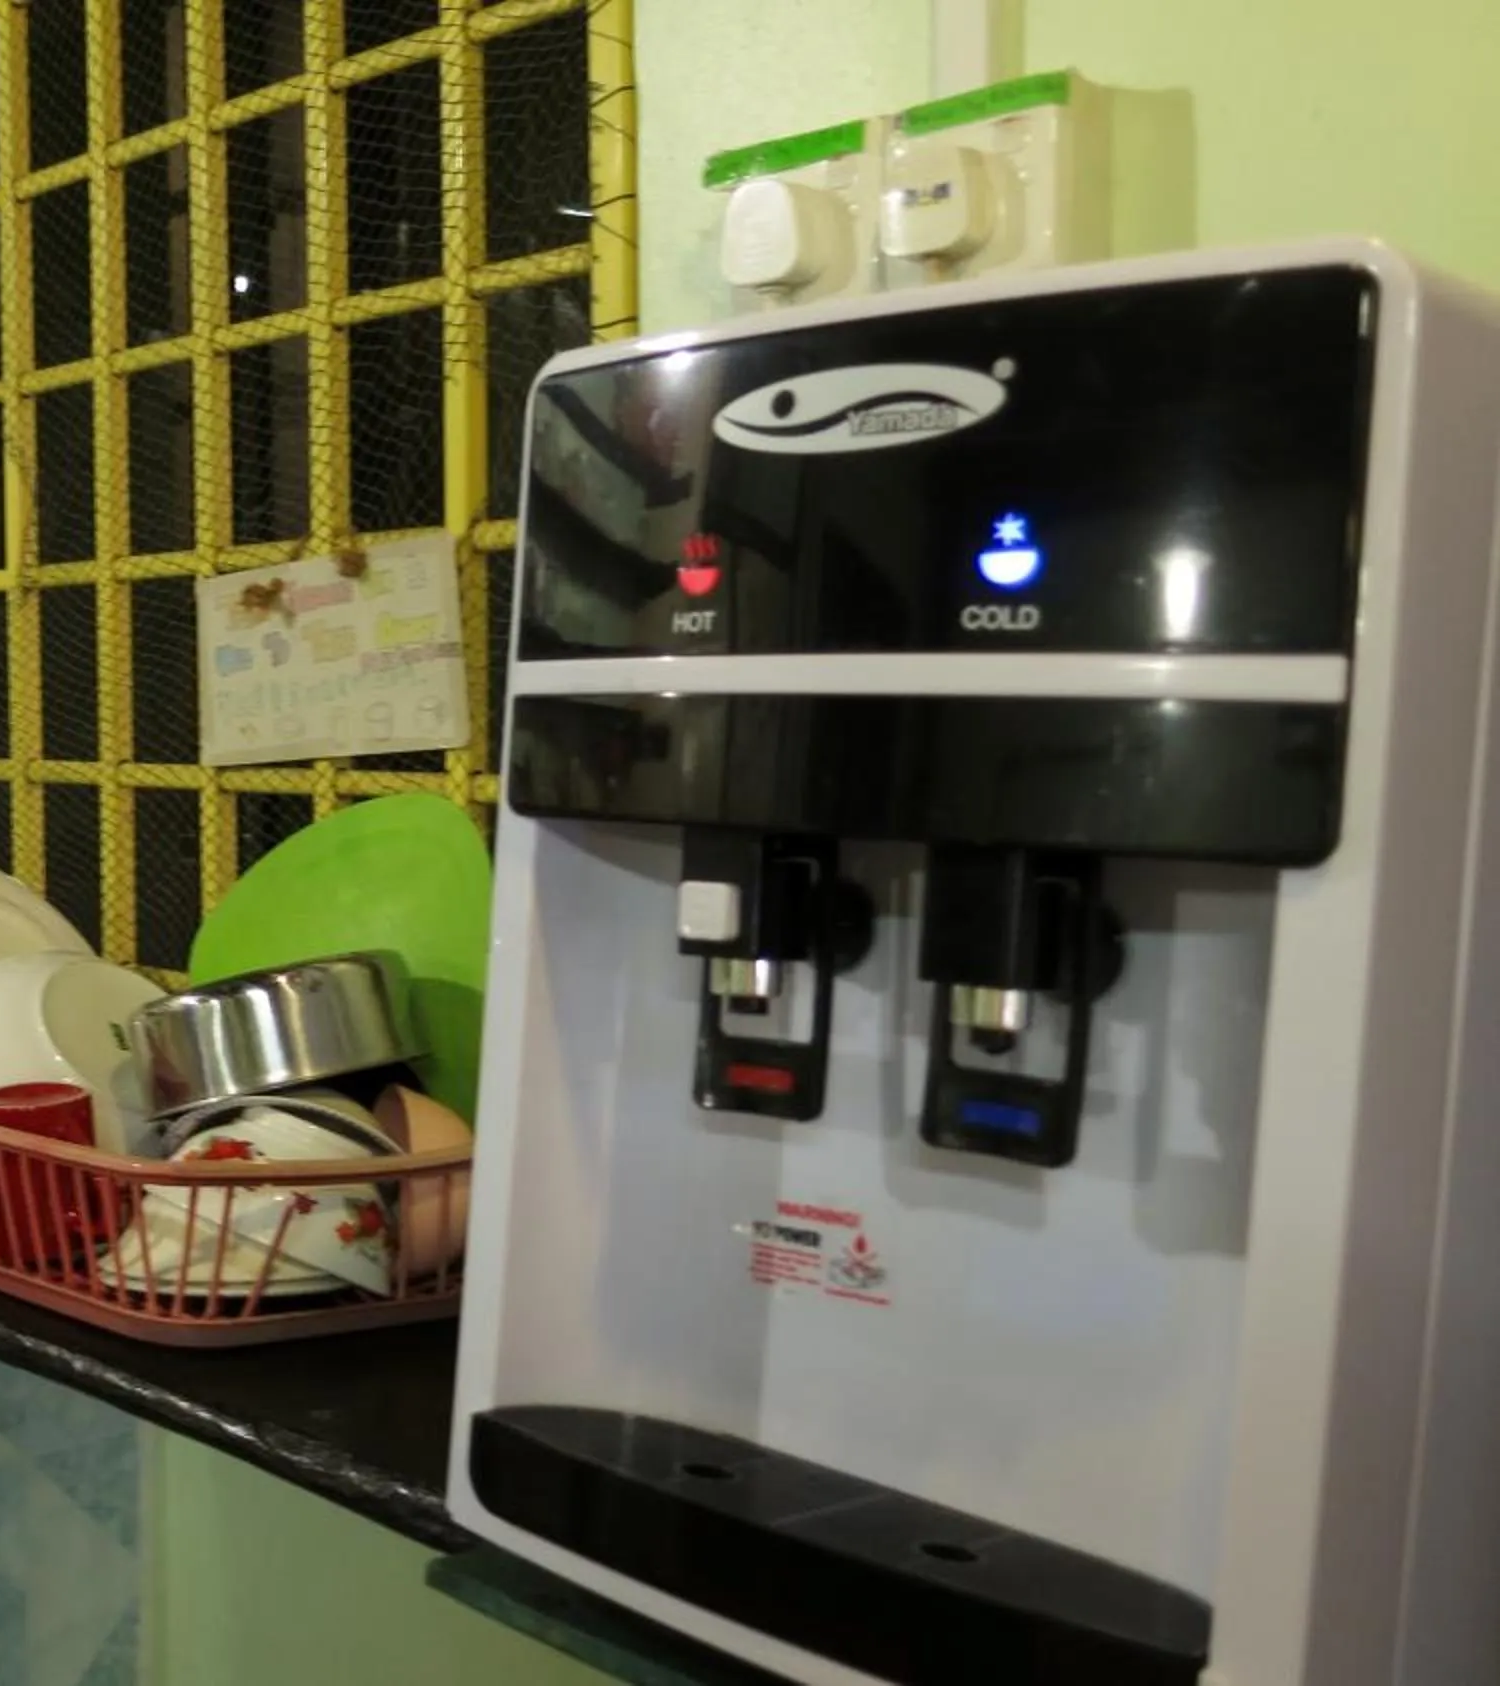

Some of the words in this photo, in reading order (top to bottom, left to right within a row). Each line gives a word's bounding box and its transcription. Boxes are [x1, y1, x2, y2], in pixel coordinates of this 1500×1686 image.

[848, 404, 957, 435] Yamada
[672, 611, 716, 632] HOT
[961, 605, 1040, 630] COLD
